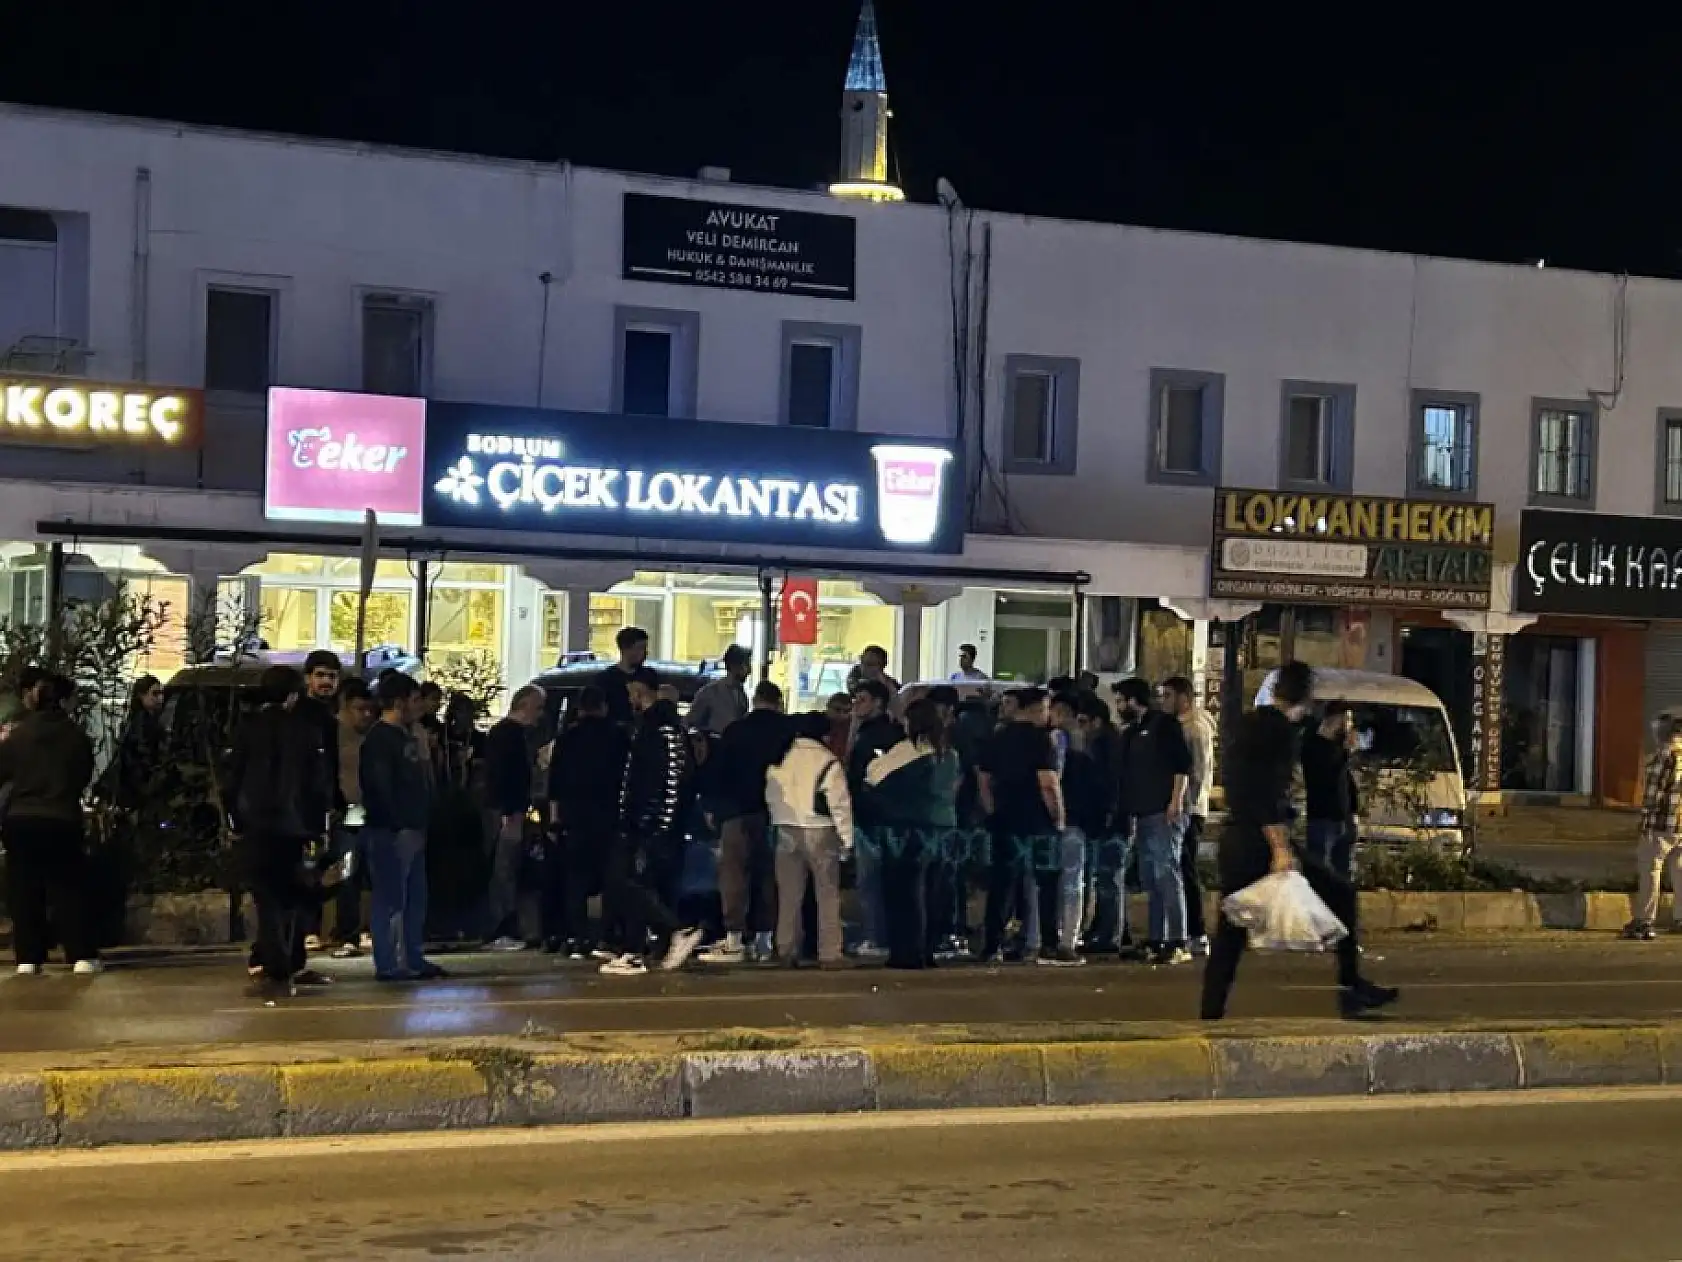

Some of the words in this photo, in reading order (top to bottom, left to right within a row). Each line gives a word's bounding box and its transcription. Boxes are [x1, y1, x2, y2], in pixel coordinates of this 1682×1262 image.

[706, 210, 780, 230] AVUKAT
[667, 247, 713, 264] HUKUK
[715, 253, 726, 266] &
[487, 456, 619, 512] ÇİÇEK
[624, 469, 861, 521] LOKANTASI
[1225, 493, 1377, 539] LOKMAN
[1384, 503, 1490, 544] HEKİM
[1526, 537, 1617, 597] ÇELİK
